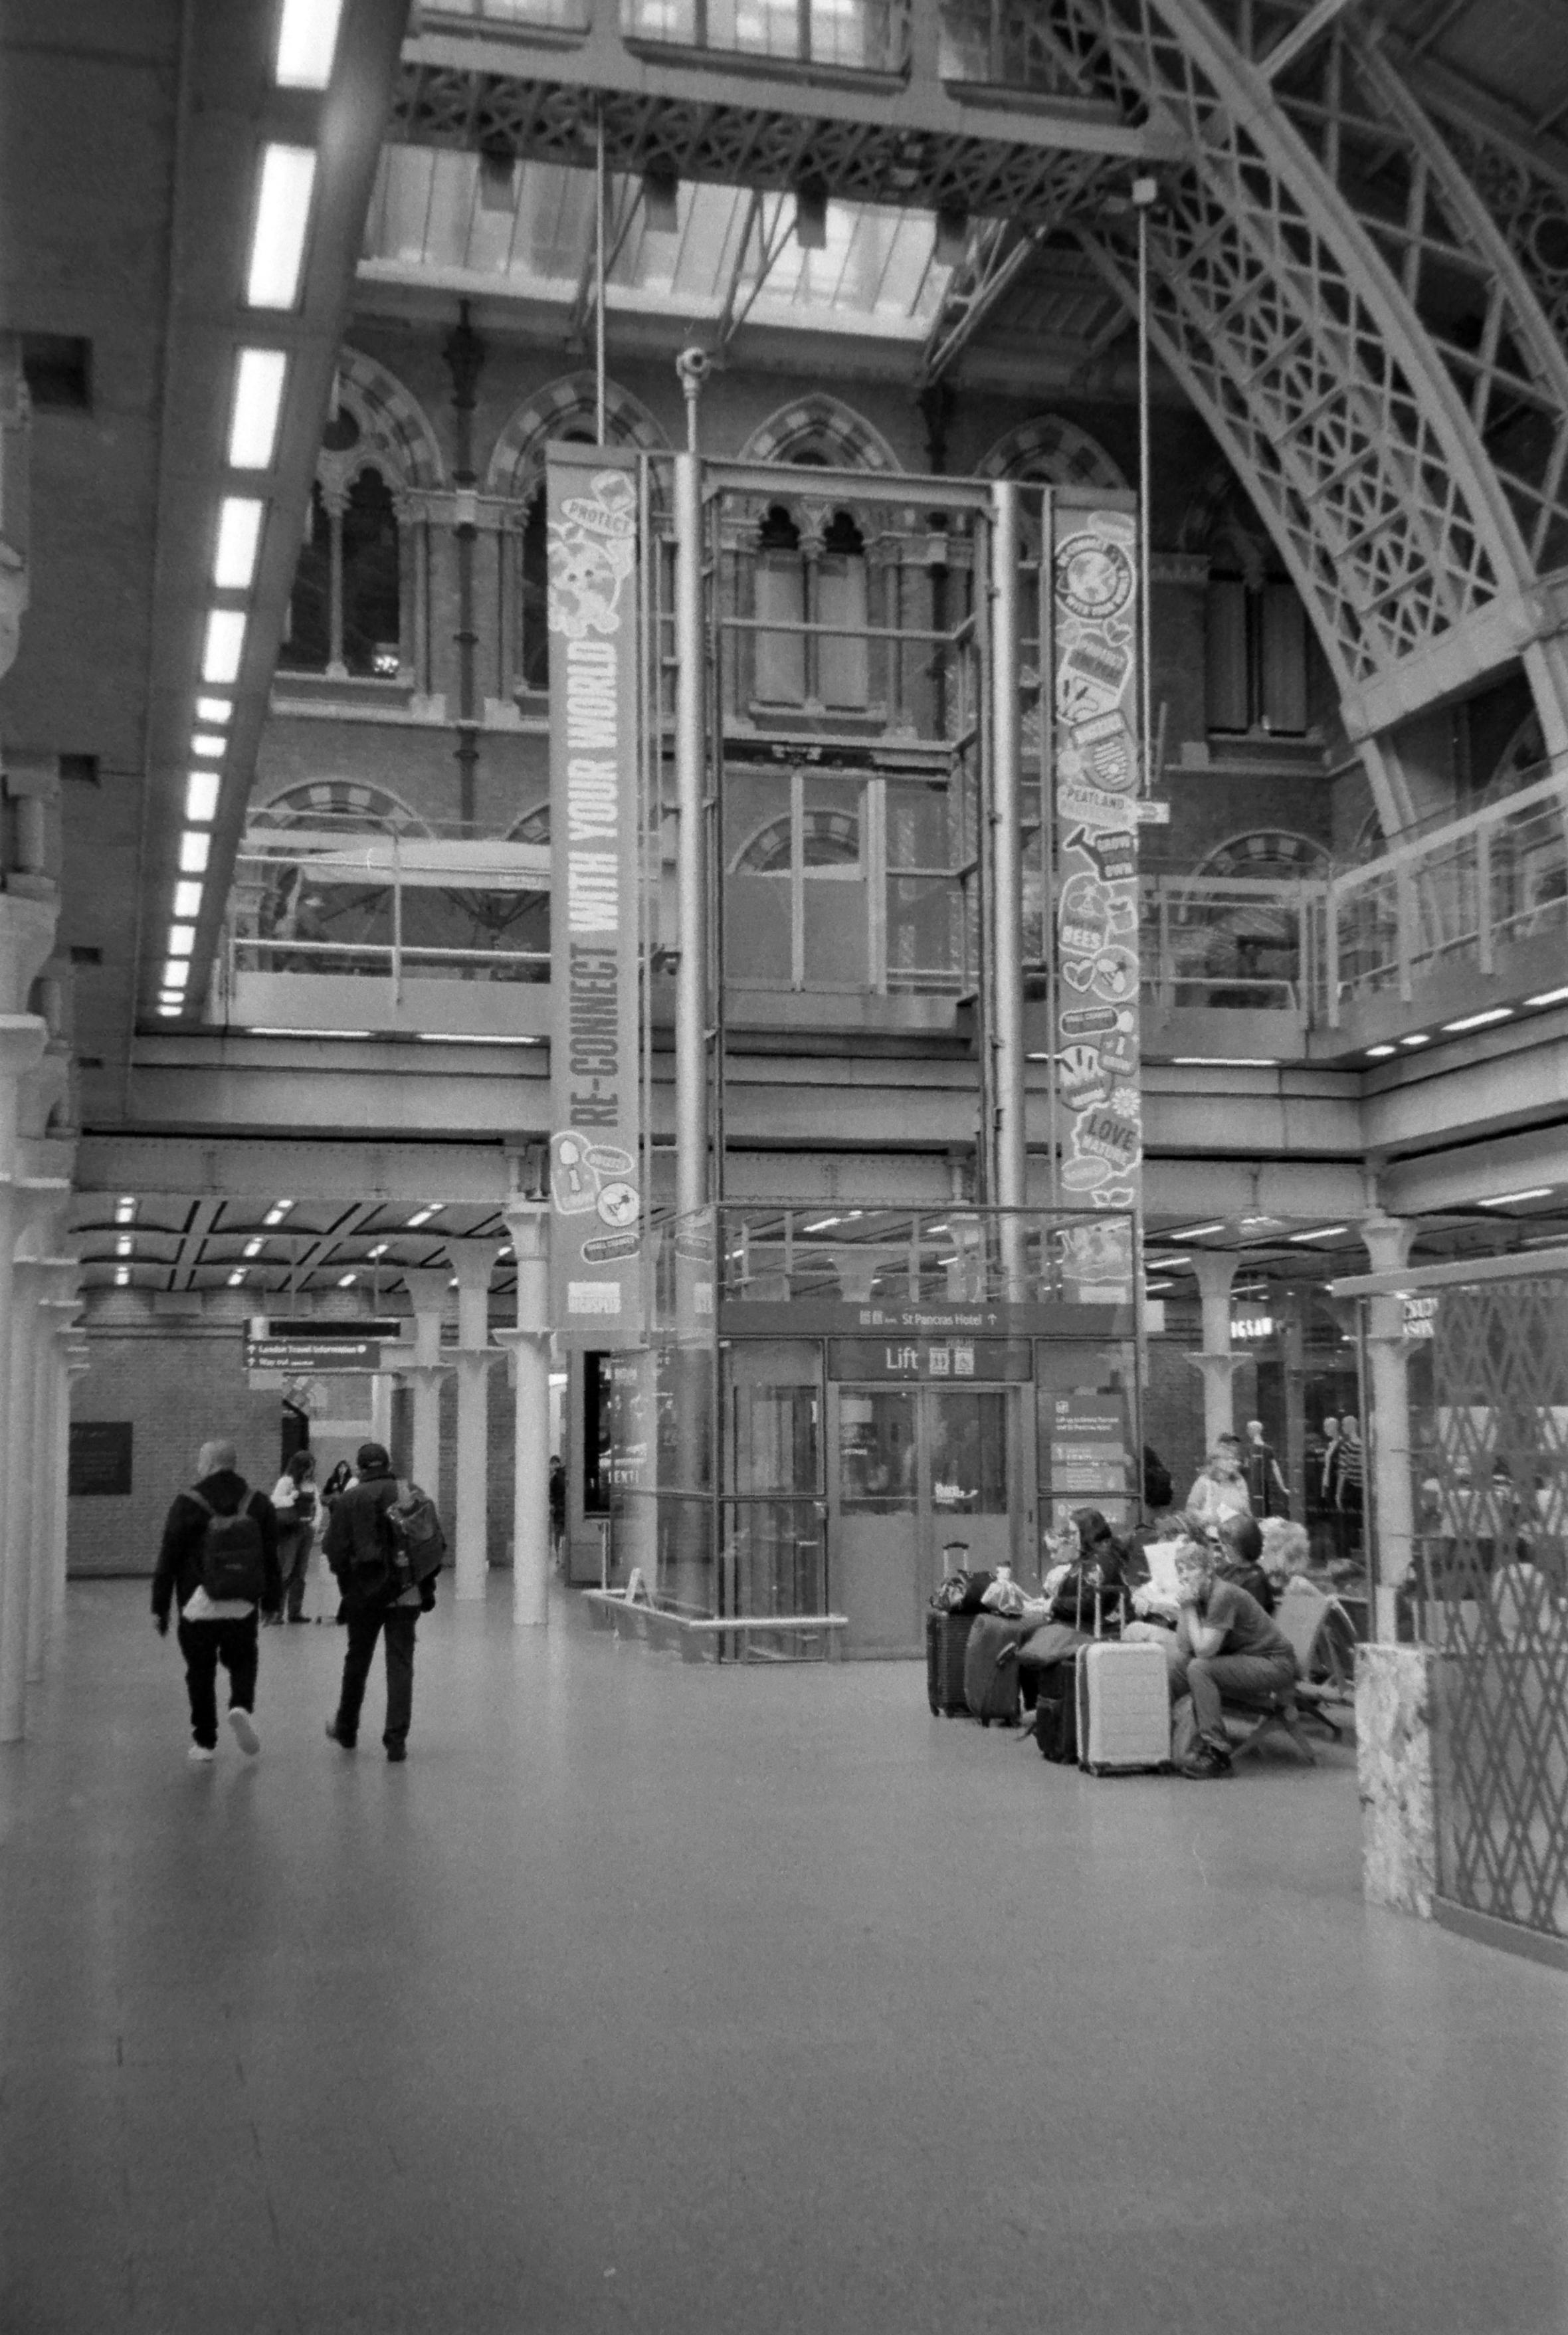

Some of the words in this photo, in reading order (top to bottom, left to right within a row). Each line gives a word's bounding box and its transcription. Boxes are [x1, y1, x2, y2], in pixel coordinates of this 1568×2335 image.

[570, 502, 629, 532] PROTECT
[566, 641, 618, 748] WORLD
[567, 759, 618, 841] YOUR
[1066, 787, 1125, 809] PEATLAND
[567, 851, 618, 932] WITH
[1062, 926, 1101, 949] BEES
[567, 942, 619, 1128] RE-CONNECT
[1087, 1114, 1136, 1151] LOVE
[1082, 1135, 1130, 1166] NATURE
[915, 1313, 953, 1325] Pancras
[955, 1313, 983, 1325] Hotel
[1230, 1317, 1272, 1338] IGSAW
[886, 1346, 919, 1370] Lift
